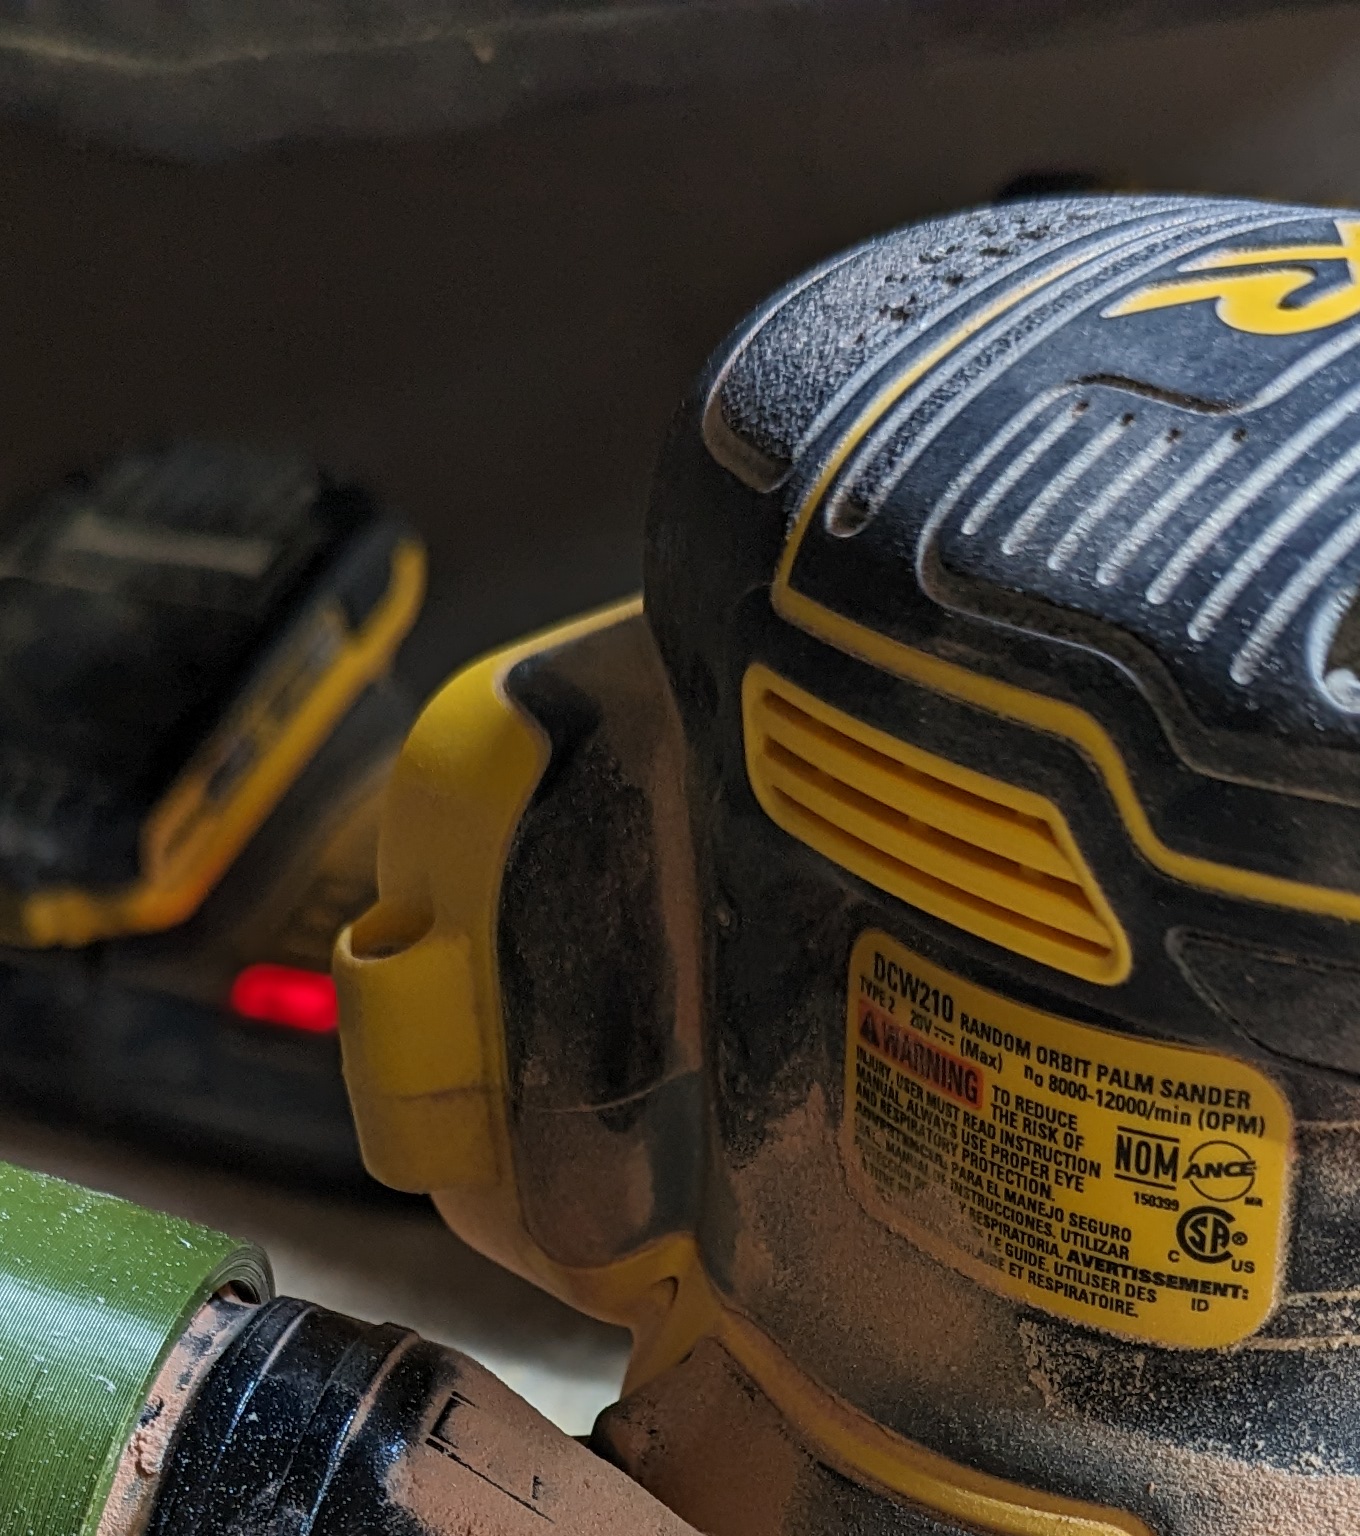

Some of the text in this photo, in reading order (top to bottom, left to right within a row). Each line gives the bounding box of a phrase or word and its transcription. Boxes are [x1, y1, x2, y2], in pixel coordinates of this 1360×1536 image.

[859, 975, 886, 1009] TYPE
[909, 1008, 933, 1036] 20V
[960, 1036, 1003, 1074] (Max)
[1048, 1074, 1192, 1127] 8000-12000/min
[1198, 1108, 1266, 1138] (OPM)
[873, 951, 1251, 1110] DCW210 RANDOM ORBIT PALM SANDER
[881, 1020, 1078, 1131] WARNING TO REDUCE
[855, 1081, 878, 1108] AND
[880, 1099, 959, 1158] RESPIRATORY
[961, 1150, 1056, 1202] PROTECTION.
[896, 1071, 924, 1103] USER
[925, 1091, 960, 1122] MUST
[963, 1110, 996, 1141] READ
[1000, 1126, 1101, 1179] INSTRUCTION
[906, 1099, 958, 1140] ALWAYS
[961, 1128, 987, 1155] USE
[991, 1146, 1050, 1178] PROPER
[1054, 1169, 1085, 1193] EYE
[990, 1104, 1085, 1152] THE RISK OF
[1114, 1133, 1181, 1183] NOM
[951, 1161, 984, 1188] PARA
[986, 1179, 1001, 1198] EL
[1003, 1187, 1065, 1223] MANEJO
[1068, 1213, 1132, 1243] SEGURO
[1181, 1160, 1257, 1181] ANCE
[950, 1178, 1056, 1239] INSTRUCCIONES.
[1060, 1230, 1130, 1261] UTILIZAR
[969, 1207, 1064, 1260] RESPIRATORIA.
[1066, 1250, 1250, 1301] AVERTISSEMENT:
[1005, 1242, 1050, 1273] GUIDE.
[1053, 1260, 1120, 1295] UTILISER
[1124, 1282, 1158, 1304] DES
[1191, 1298, 1210, 1312] ID
[1009, 1262, 1025, 1280] ET
[1027, 1269, 1140, 1319] RESPIRATOIRE.
[1167, 1250, 1256, 1274] C US
